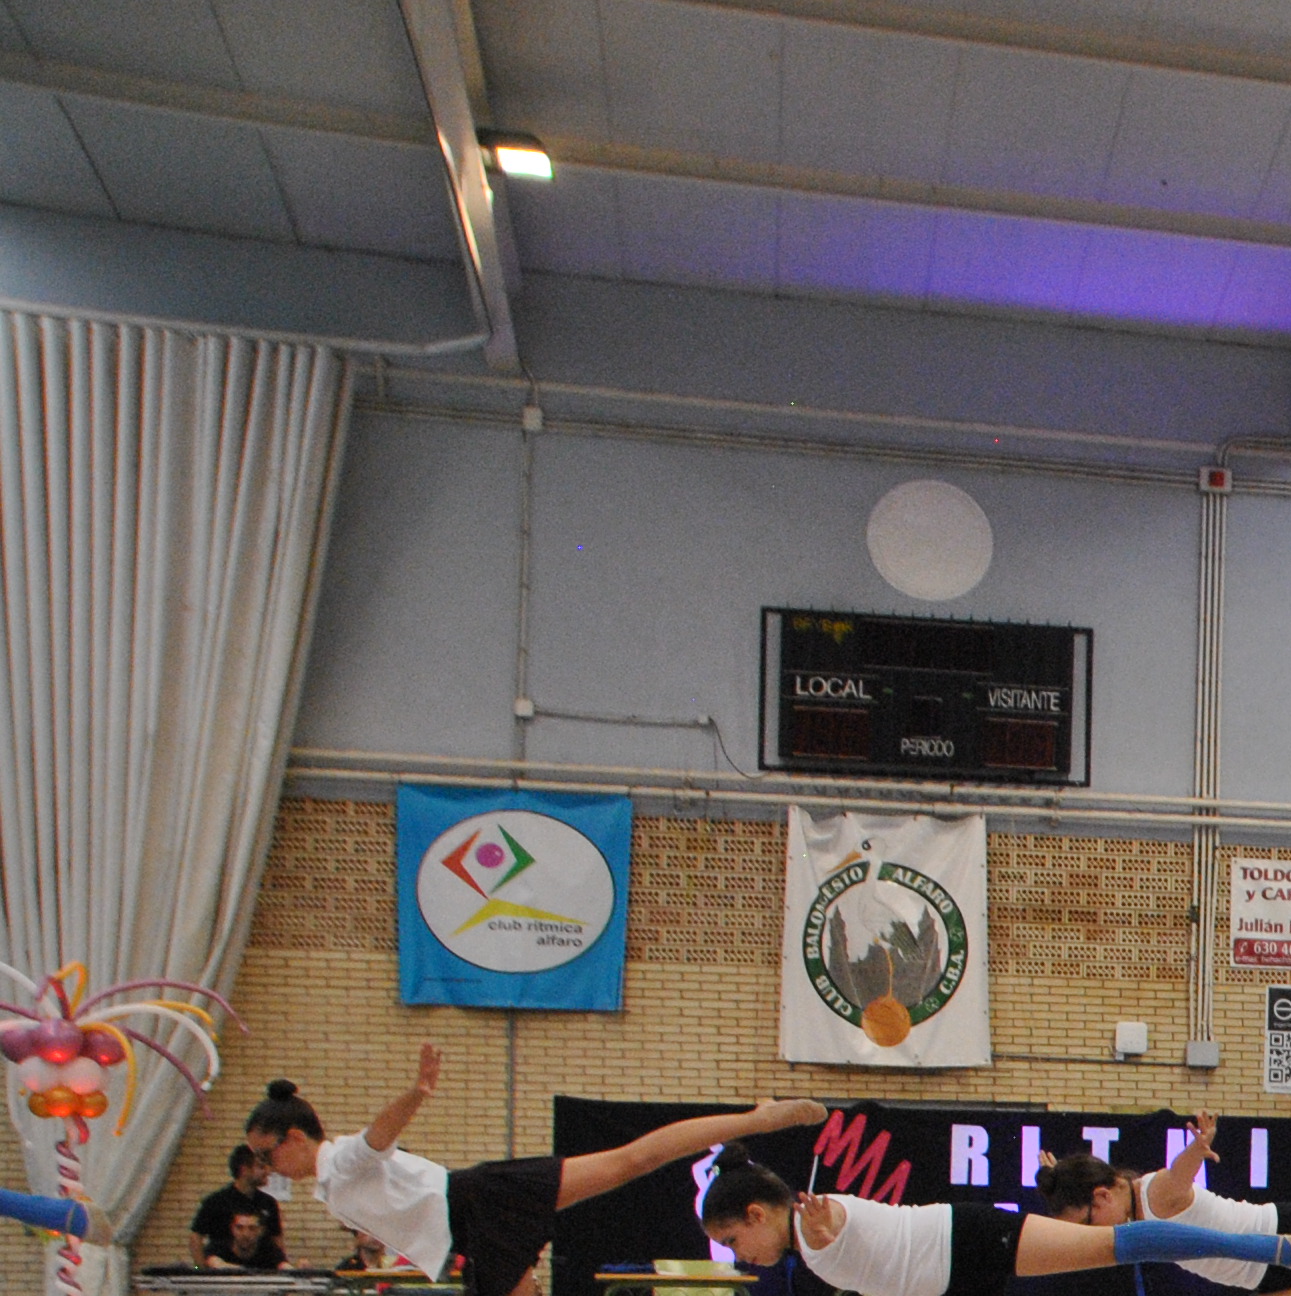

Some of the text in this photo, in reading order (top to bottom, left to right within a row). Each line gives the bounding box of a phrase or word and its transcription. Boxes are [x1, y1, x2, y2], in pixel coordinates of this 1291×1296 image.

[795, 676, 872, 699] LOCAL
[988, 688, 1061, 711] VISITANTE
[891, 866, 952, 913] ALFARO
[1245, 890, 1255, 902] y
[806, 866, 863, 959] BALOESTO
[488, 919, 522, 932] club
[536, 935, 583, 947] alfaro
[1253, 941, 1277, 954] 630
[815, 974, 852, 1016] CLUB
